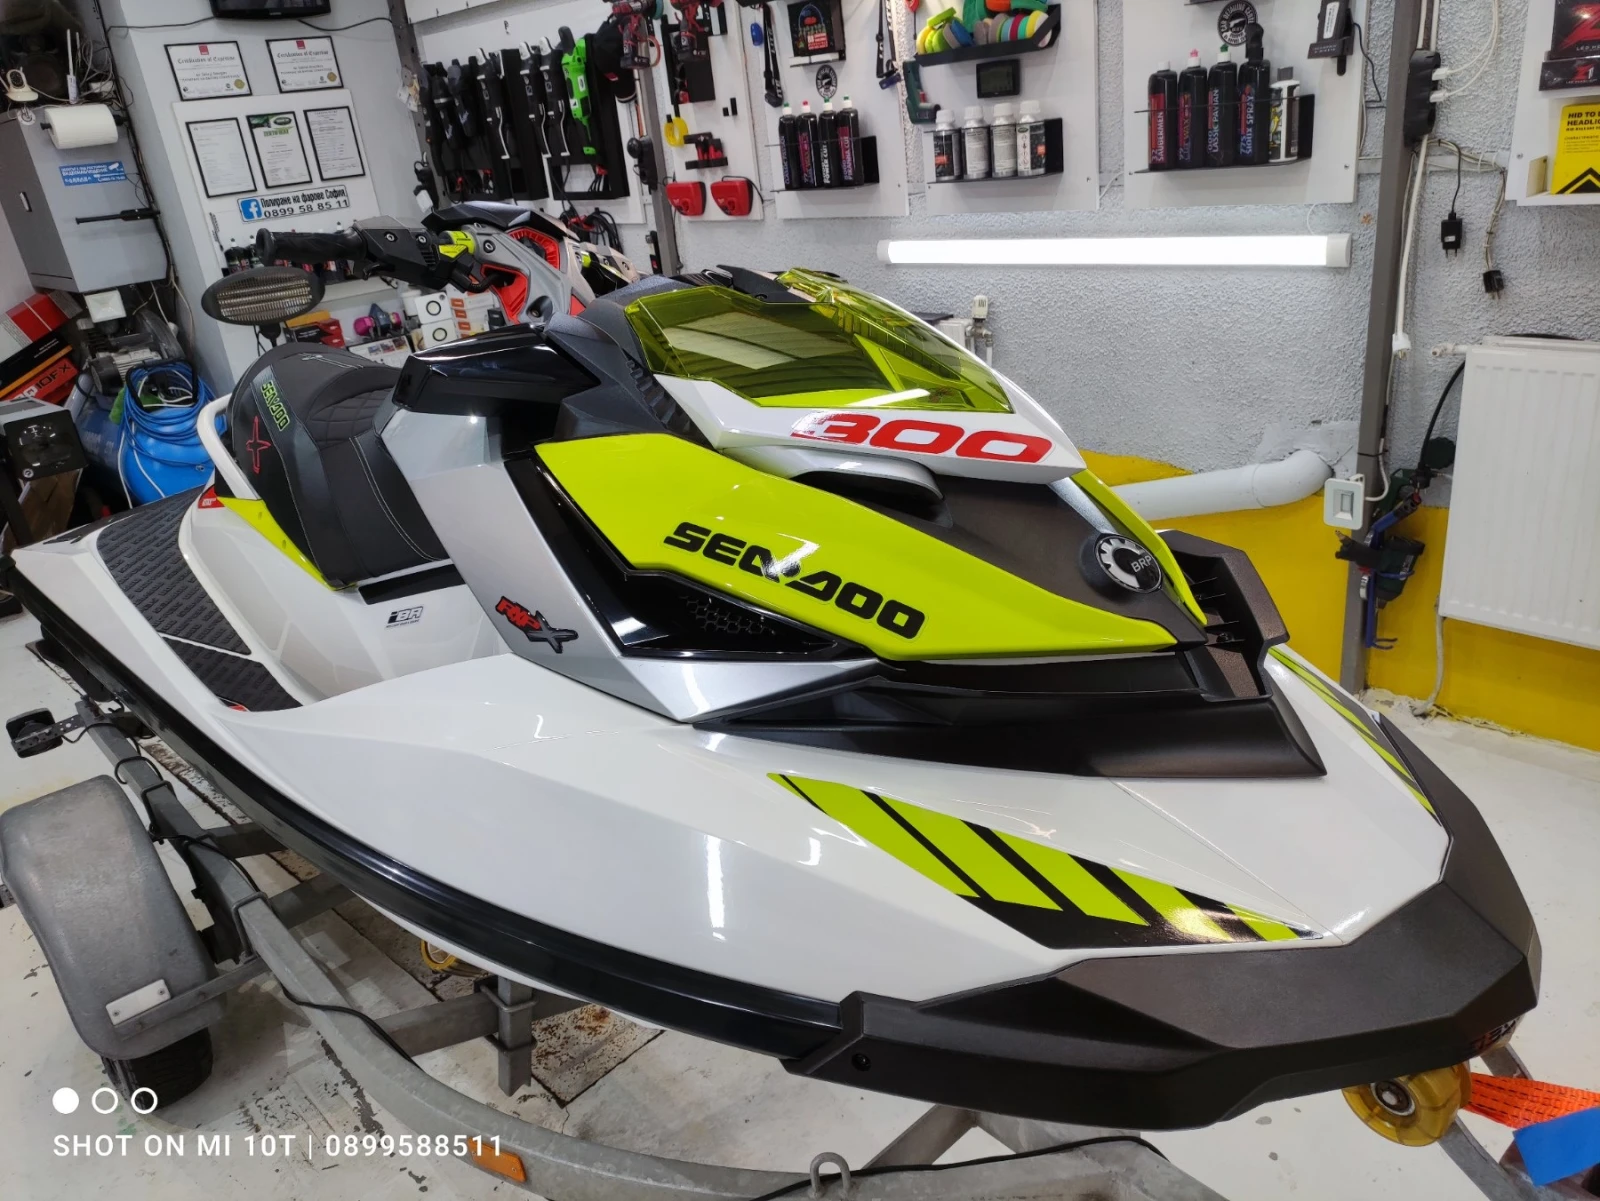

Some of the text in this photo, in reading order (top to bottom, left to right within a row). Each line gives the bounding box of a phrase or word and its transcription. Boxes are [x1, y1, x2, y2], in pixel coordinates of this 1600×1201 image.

[260, 188, 345, 208] Полиране на фарове София
[264, 200, 348, 218] 0899 58 85 11
[790, 412, 1053, 463] 300
[1131, 555, 1152, 573] BRP
